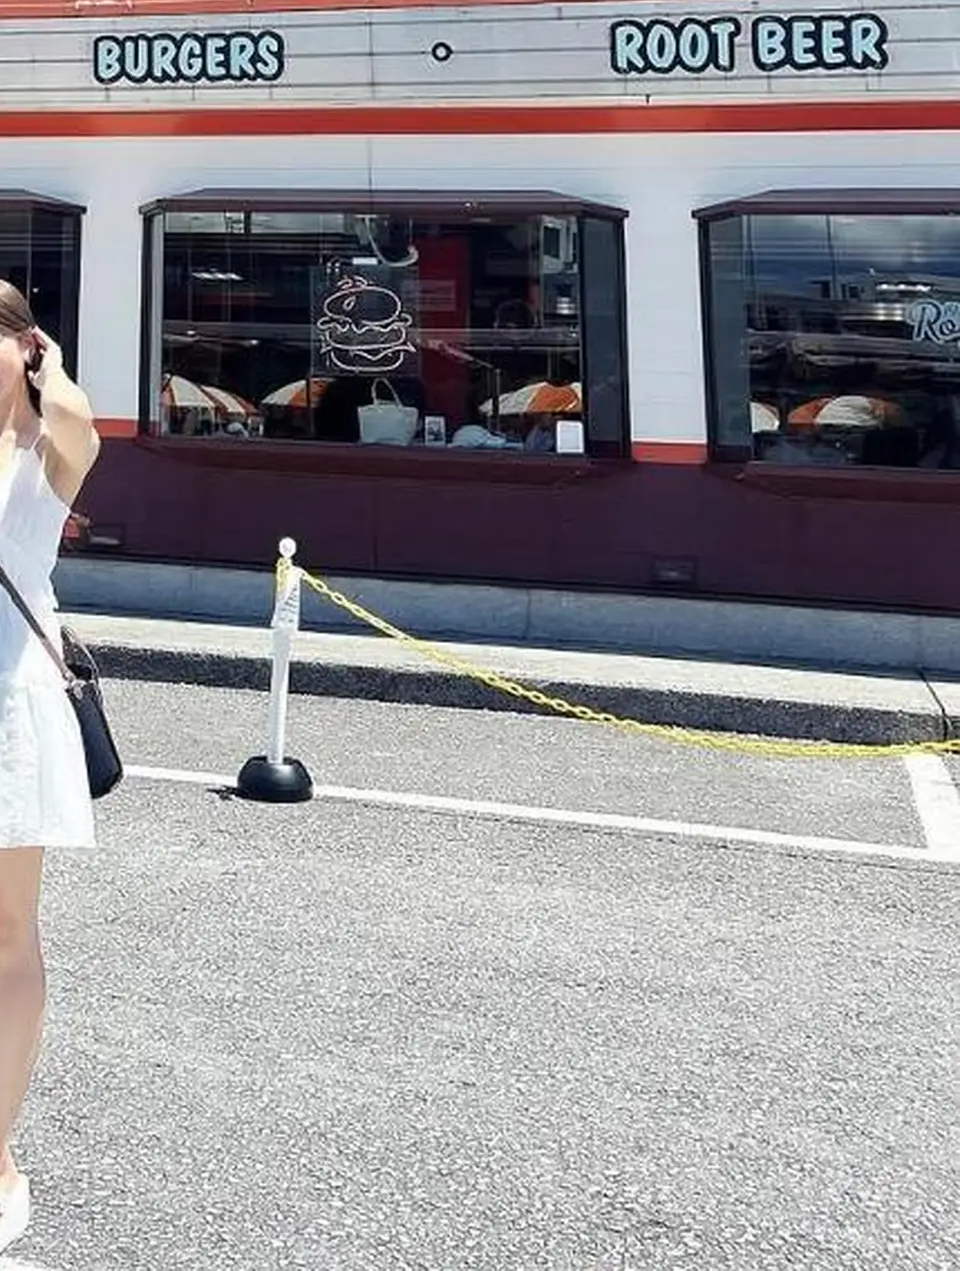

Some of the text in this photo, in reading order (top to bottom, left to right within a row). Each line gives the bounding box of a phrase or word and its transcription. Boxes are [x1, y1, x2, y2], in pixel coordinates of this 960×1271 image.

[93, 31, 284, 83] BURGERS
[610, 14, 888, 73] ROOT BEER
[905, 299, 960, 345] Ro
